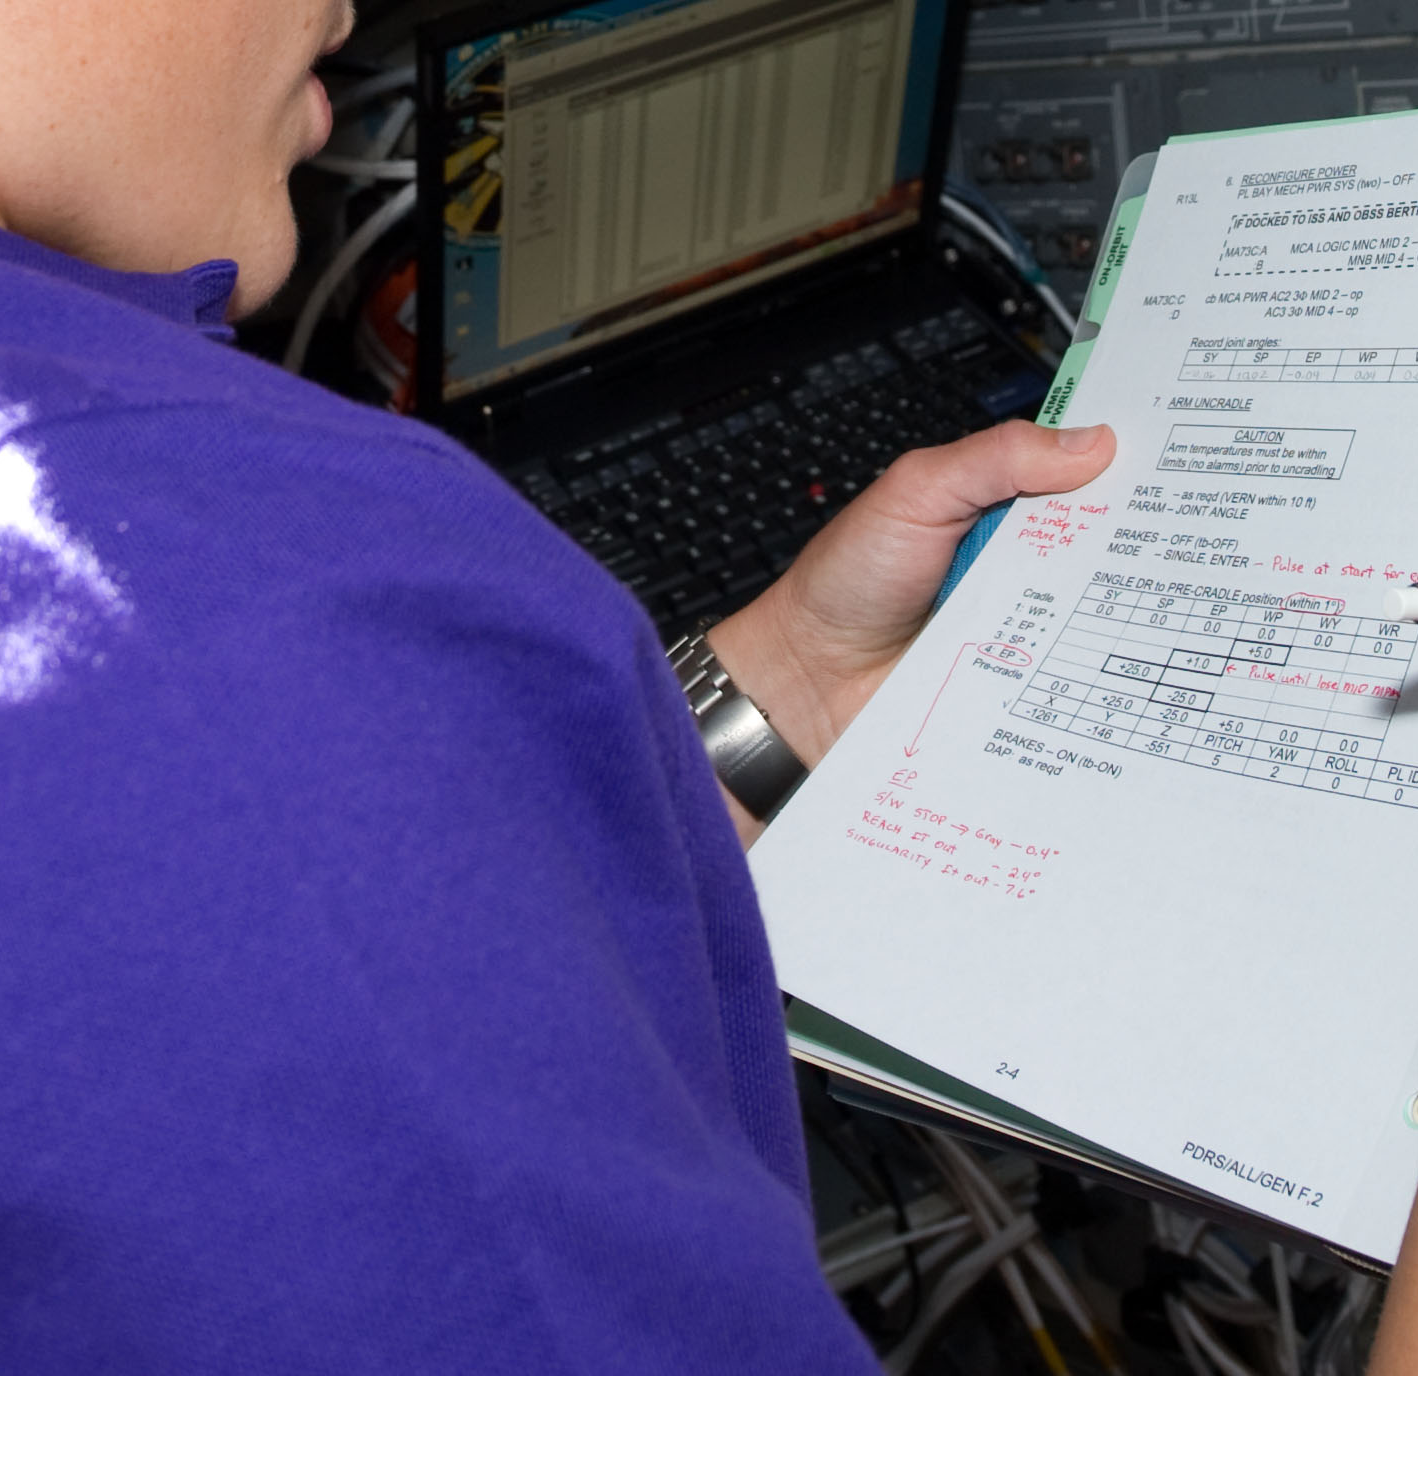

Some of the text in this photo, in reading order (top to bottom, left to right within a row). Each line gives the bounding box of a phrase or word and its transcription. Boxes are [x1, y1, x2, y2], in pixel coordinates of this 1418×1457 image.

[1237, 174, 1415, 199] PL BAY MECH PWR SYS (two) OFF
[1241, 165, 1357, 185] RECONFIGURE POWER
[1233, 218, 1243, 228] IF
[1244, 213, 1289, 228] DOCKED
[1292, 213, 1306, 225] TO
[1307, 212, 1325, 224] ISS
[1327, 211, 1350, 223] AND
[1353, 208, 1383, 222] OBSS
[1099, 226, 1125, 286] ON-ORBIT
[1114, 244, 1129, 266] INIT
[1190, 338, 1223, 348] Record
[1225, 337, 1245, 349] joint
[1043, 387, 1061, 414] RMS
[1048, 378, 1074, 424] PWRUP
[1168, 397, 1253, 409] ARM UNCRADLE
[1234, 430, 1284, 441] CAUTION
[1167, 443, 1326, 460] Arm temperatures must be within
[1162, 458, 1335, 478] limits (no alarms) prior to uncradling
[1127, 500, 1249, 520] PARAM JOINT ANGLE
[1133, 486, 1317, 510] RATE as reqd (VERN within 10 ft)
[1114, 528, 1159, 543] BRAKES
[1170, 534, 1192, 546] OFF
[1107, 543, 1140, 556] MODE
[1210, 555, 1249, 568] ENTER
[1272, 556, 1304, 574] Pulse
[1315, 562, 1329, 575] at
[1341, 566, 1375, 580] start
[1383, 564, 1403, 580] for
[1092, 572, 1322, 610] SINGLE DR to PRE-CRADLE position (within
[1105, 590, 1401, 637] SY SP EP WP WY WR
[973, 658, 1023, 680] Pre-cradle
[1119, 663, 1151, 677] +25.0
[1186, 656, 1210, 669] +1.0
[1026, 709, 1171, 754] -1261 -146 -551
[993, 729, 1122, 779] BRAKES ON (tb-ON)
[1205, 735, 1243, 751] PITCH
[1269, 746, 1297, 762] YAW
[1325, 757, 1358, 773] ROLL
[1388, 767, 1404, 781] PL
[862, 810, 902, 834] REACH
[875, 792, 1002, 849] S/W STOP Gray
[846, 828, 931, 869] SINGULARITY
[996, 1063, 1020, 1079] 2-4
[1182, 1142, 1295, 1196] PDRS/ALL/GEN
